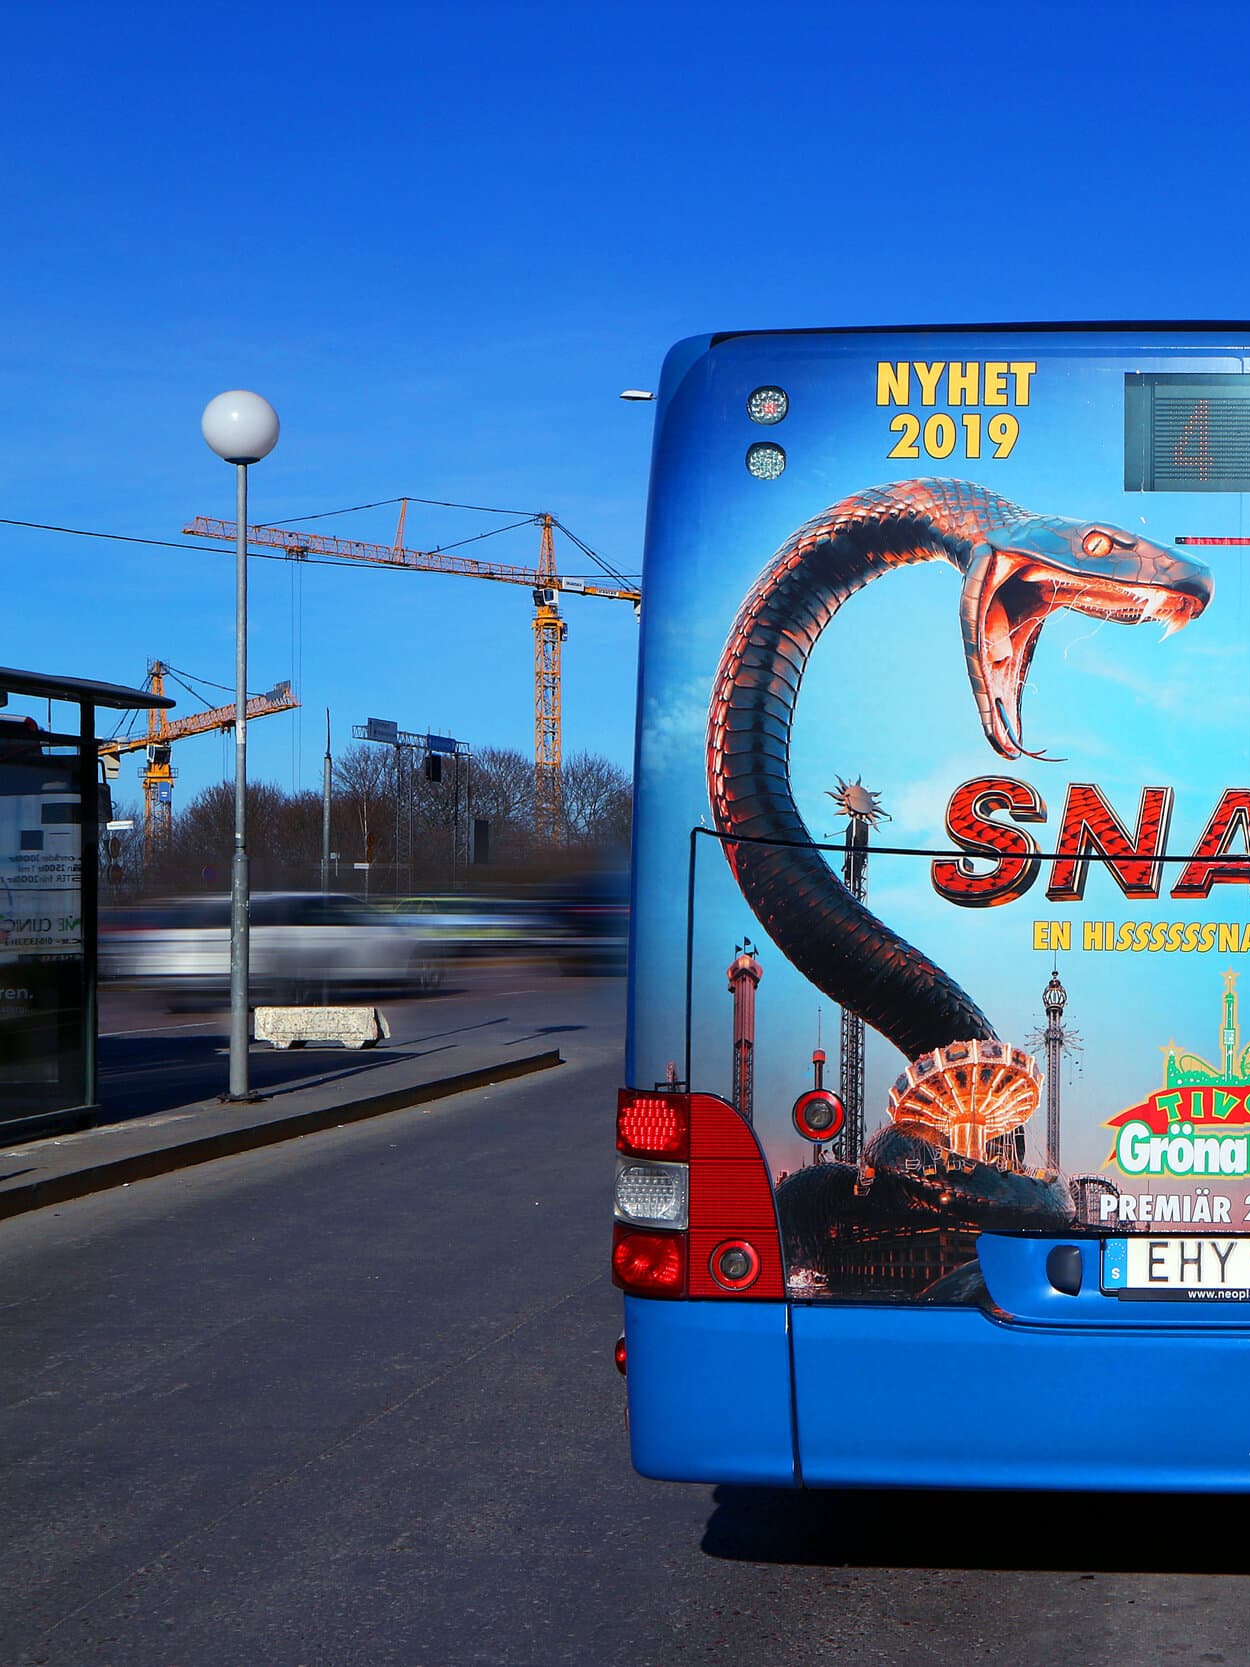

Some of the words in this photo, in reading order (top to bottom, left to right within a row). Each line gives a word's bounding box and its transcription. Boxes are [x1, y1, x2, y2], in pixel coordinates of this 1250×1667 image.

[876, 361, 1036, 406] NYHET
[887, 413, 1020, 459] 2019
[1172, 399, 1214, 481] 4
[1033, 921, 1071, 951] EN
[1118, 1122, 1250, 1175] Gröna
[1100, 1189, 1232, 1222] PREMIÄR
[1111, 1267, 1120, 1279] S
[1148, 1241, 1237, 1283] EHY
